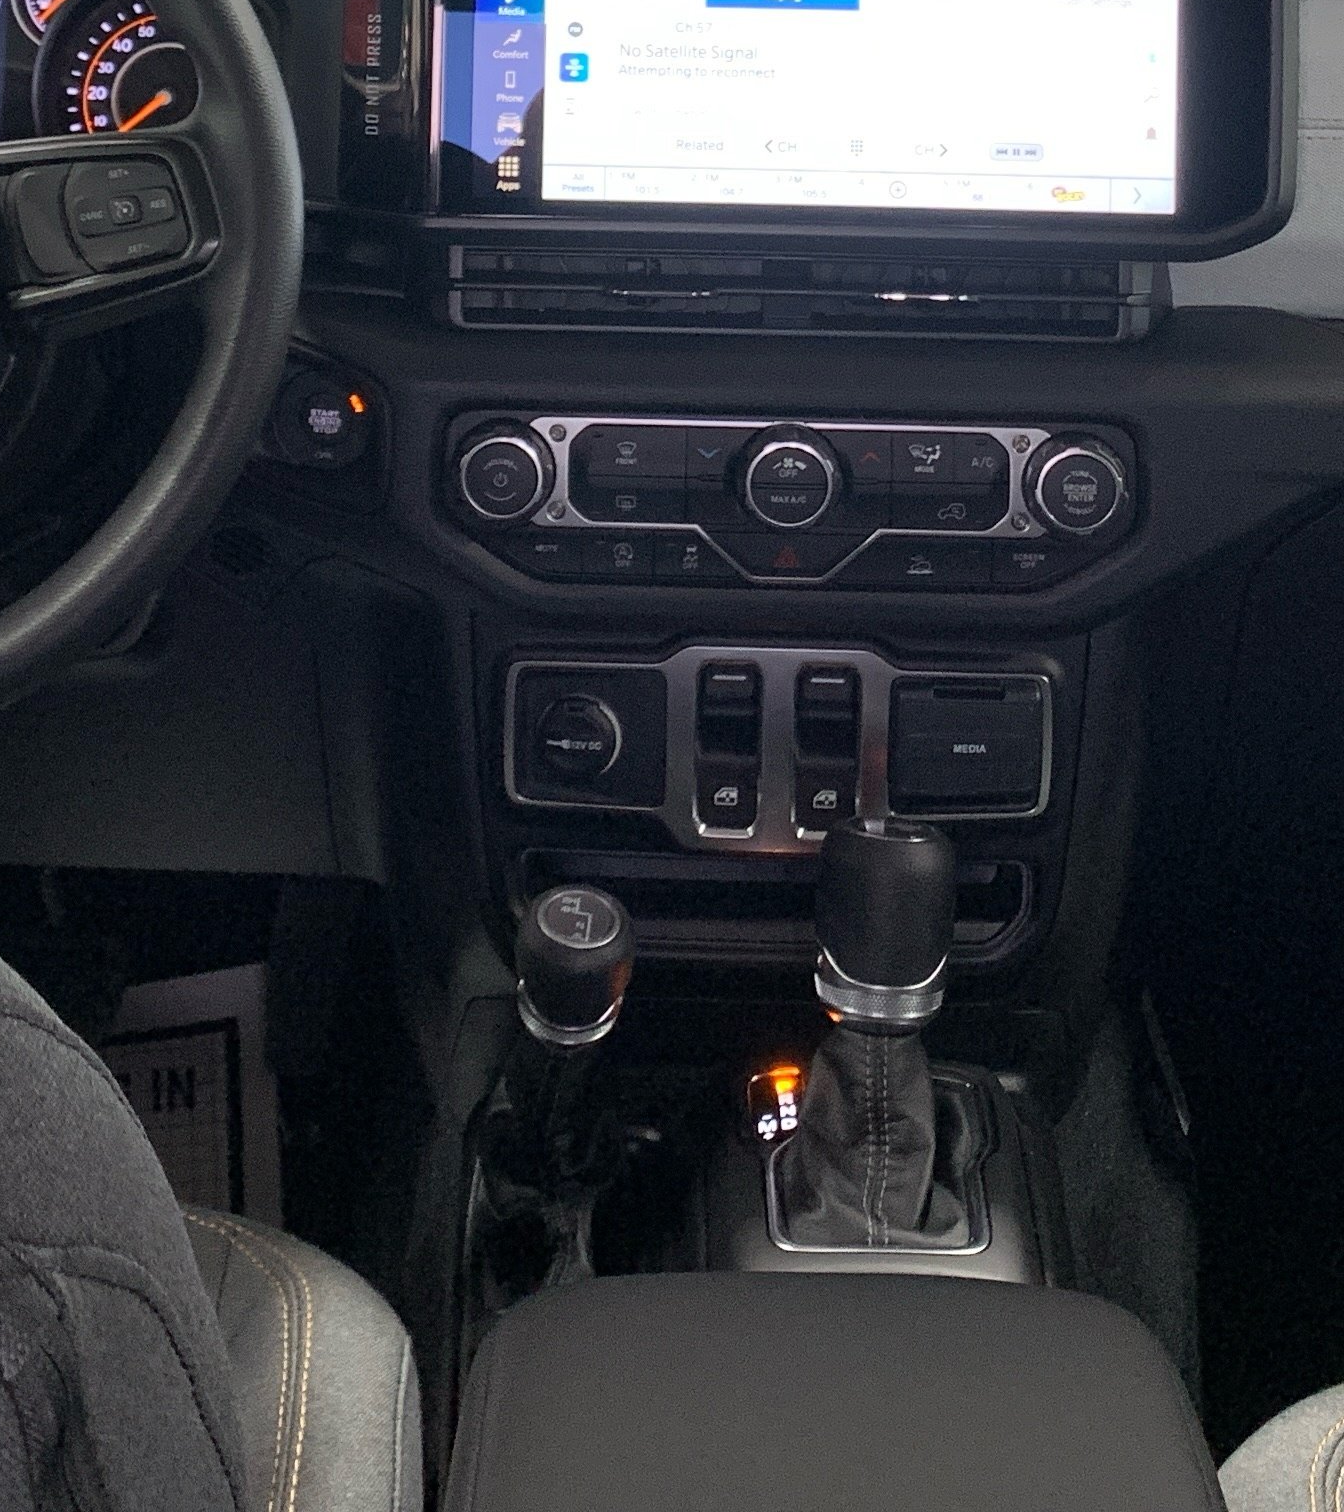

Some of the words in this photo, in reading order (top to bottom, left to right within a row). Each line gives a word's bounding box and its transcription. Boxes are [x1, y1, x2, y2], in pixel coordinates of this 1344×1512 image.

[498, 6, 526, 16] Media
[137, 25, 156, 38] 50
[675, 22, 693, 33] Ch
[112, 38, 134, 53] 40
[366, 13, 382, 67] PRESS
[492, 49, 529, 60] Comfort
[619, 43, 641, 58] No
[645, 43, 707, 59] Satellite
[710, 44, 758, 62] Signal
[97, 61, 116, 74] 30
[618, 64, 692, 78] Attempting
[695, 66, 707, 77] to
[711, 67, 775, 79] reconnect
[87, 85, 109, 101] 20
[365, 75, 381, 107] NOT
[495, 93, 524, 104] Phone
[93, 114, 109, 128] 10
[364, 114, 379, 136] DO
[492, 136, 525, 147] Vehicle
[676, 139, 724, 152] Related
[777, 140, 798, 153] CH
[913, 143, 935, 156] CH
[495, 180, 521, 192] Apps
[561, 183, 595, 194] Presets
[309, 408, 341, 418] START
[971, 457, 995, 468] A/C
[777, 469, 798, 479] OFF
[770, 495, 789, 504] MAX
[790, 495, 807, 505] A/C
[570, 741, 588, 751] 12V
[588, 741, 602, 752] DC
[952, 744, 987, 754] MEDIA
[757, 1118, 778, 1134] M
[780, 1117, 798, 1131] D
